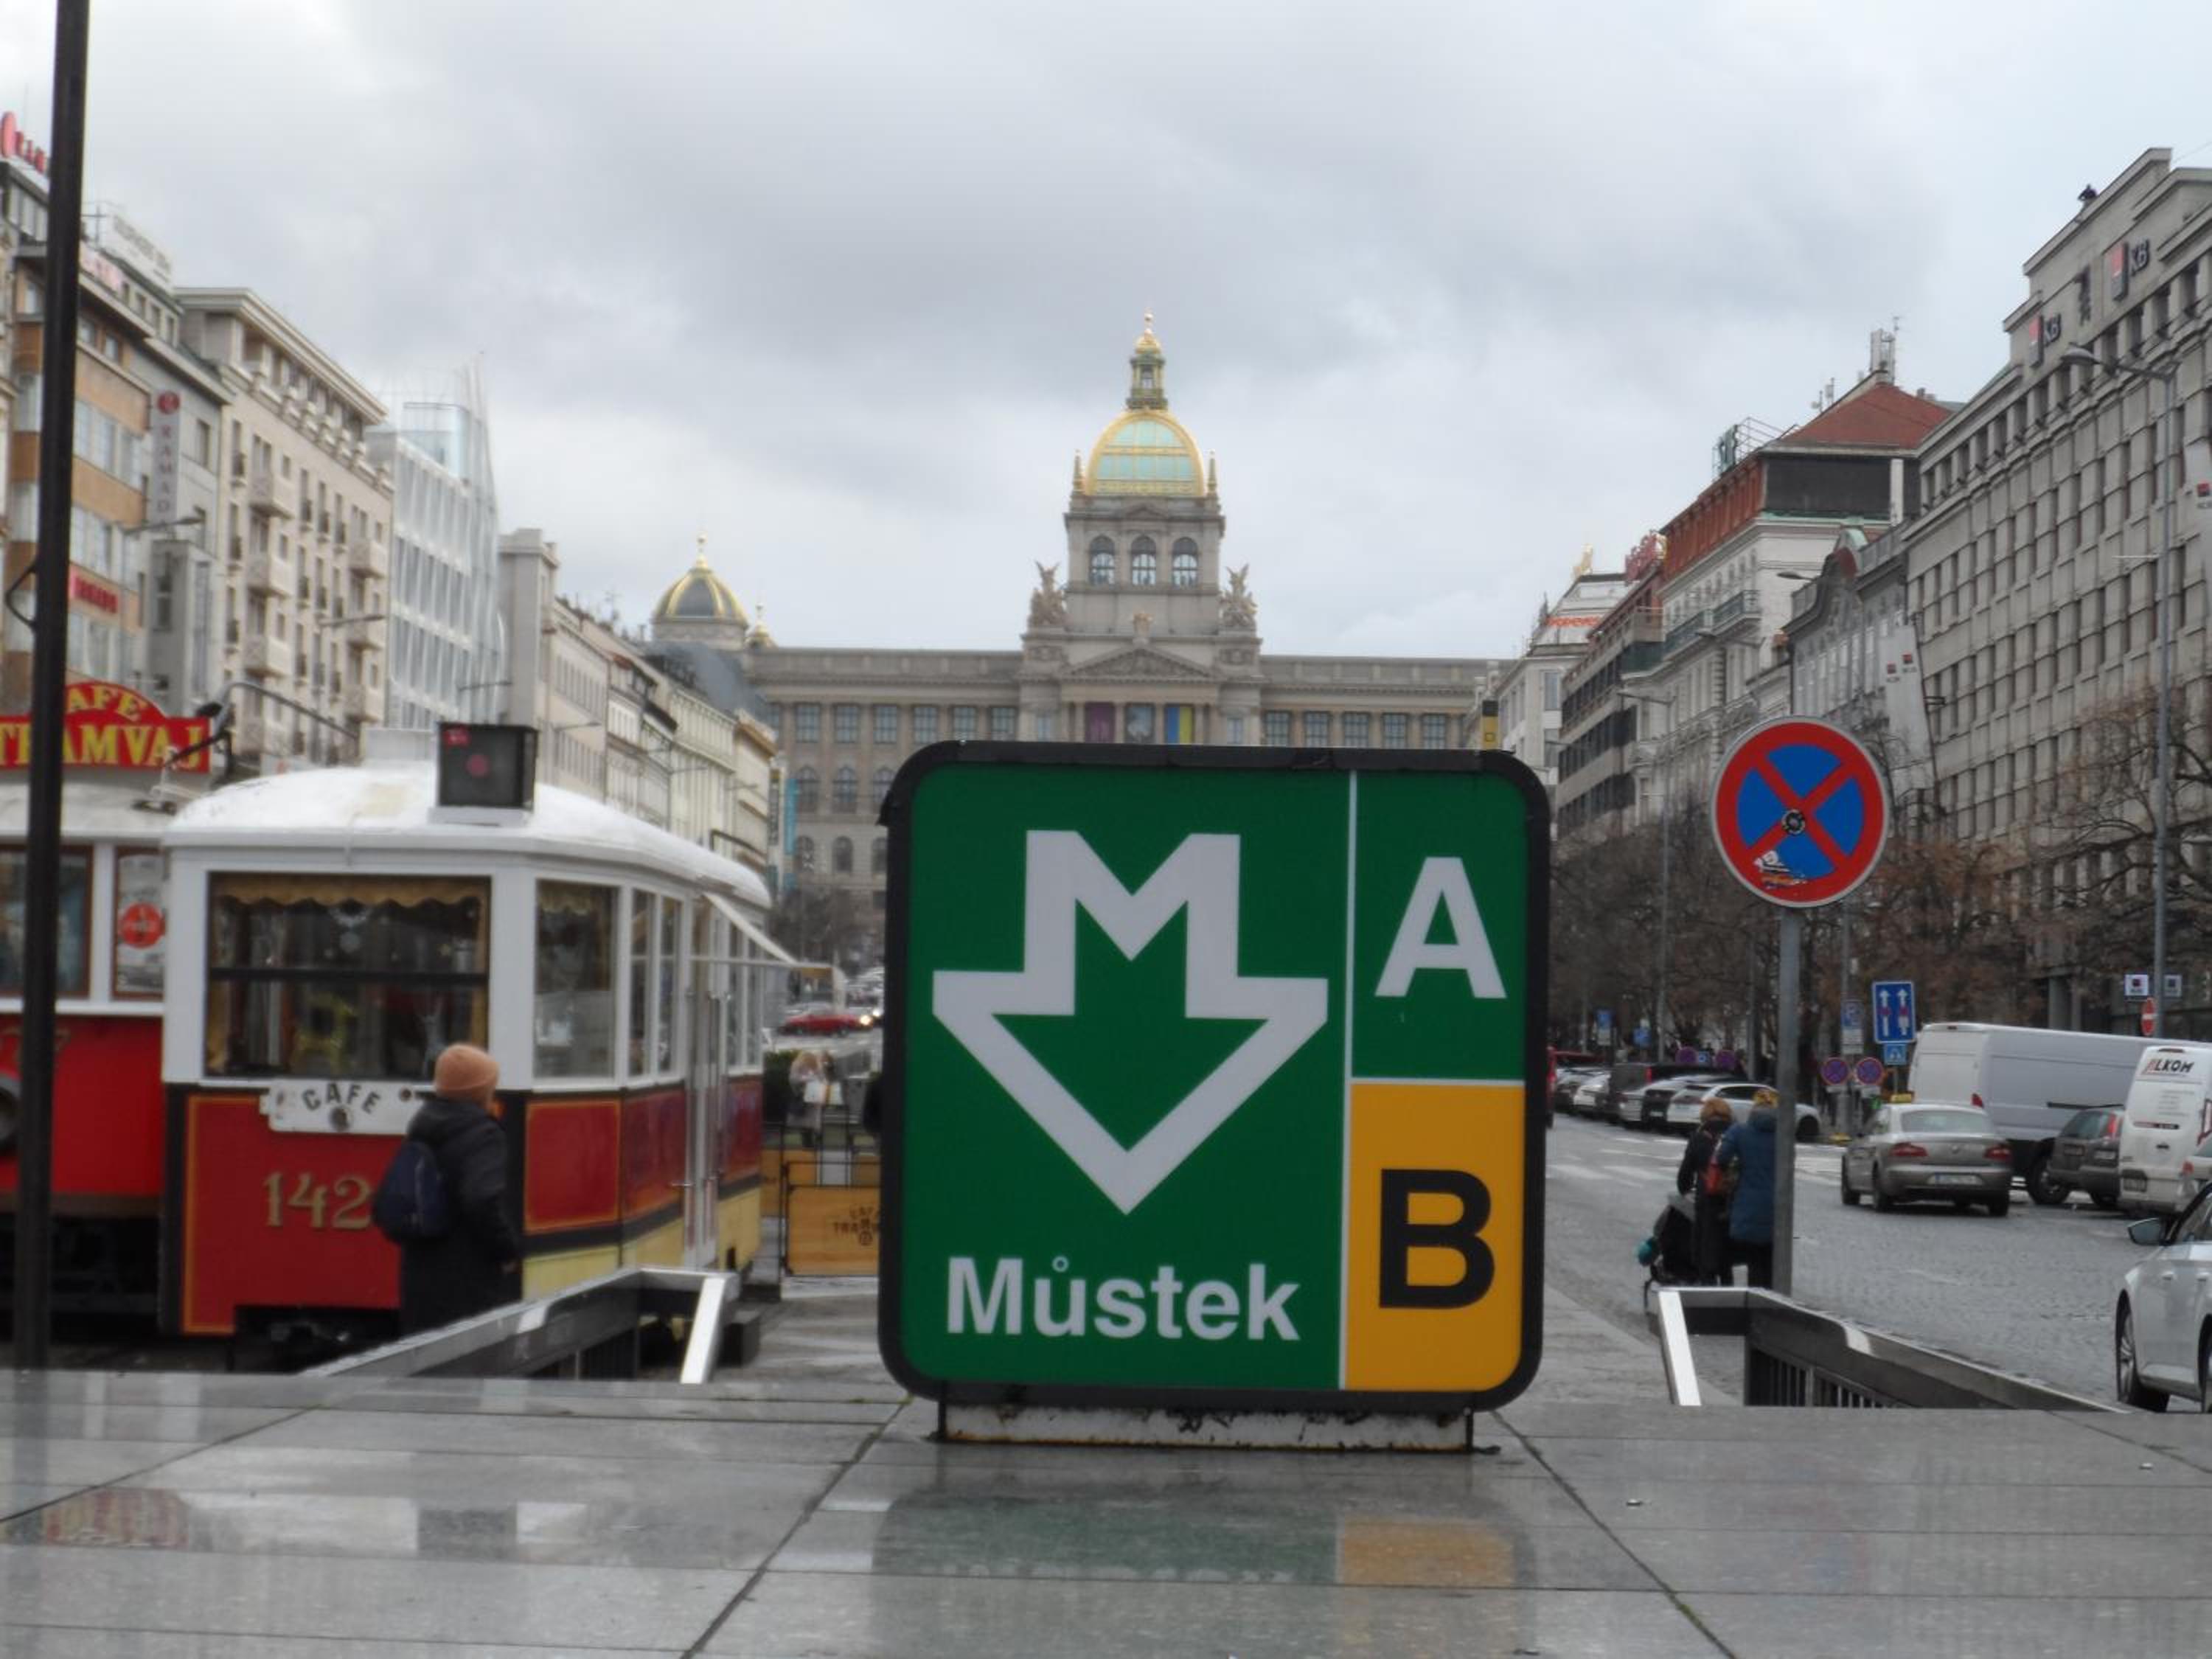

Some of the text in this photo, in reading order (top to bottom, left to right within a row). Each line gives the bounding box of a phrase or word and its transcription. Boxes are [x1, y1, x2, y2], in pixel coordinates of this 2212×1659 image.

[65, 684, 148, 721] AFE
[0, 725, 202, 768] MVAJ
[1374, 856, 1508, 999] A
[302, 1082, 381, 1114] CAFE
[262, 1171, 372, 1229] 142
[1379, 1168, 1497, 1310] B
[946, 1255, 1301, 1342] Můstek
